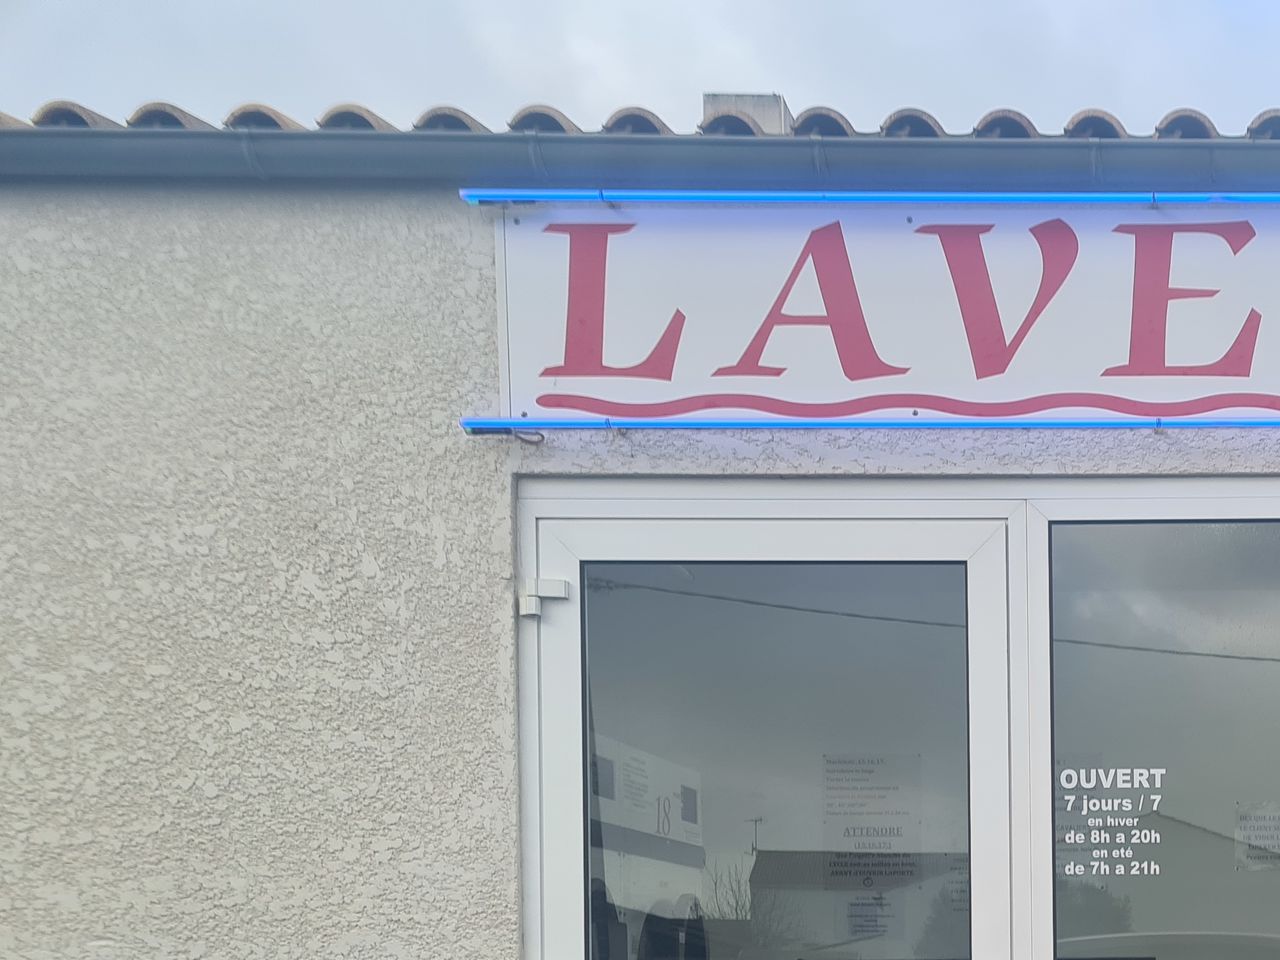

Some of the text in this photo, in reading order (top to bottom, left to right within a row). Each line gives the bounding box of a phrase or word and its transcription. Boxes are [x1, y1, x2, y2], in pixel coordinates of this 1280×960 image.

[1060, 768, 1166, 789] OUVERT
[1064, 794, 1162, 815] 7 jours / 7
[655, 796, 671, 836] 18
[1087, 815, 1139, 826] en hiver
[843, 826, 903, 837] ATTENDRE
[1065, 830, 1161, 843] de 8h a 20h
[1092, 849, 1108, 858] en
[1064, 861, 1160, 875] de 7h a 21h
